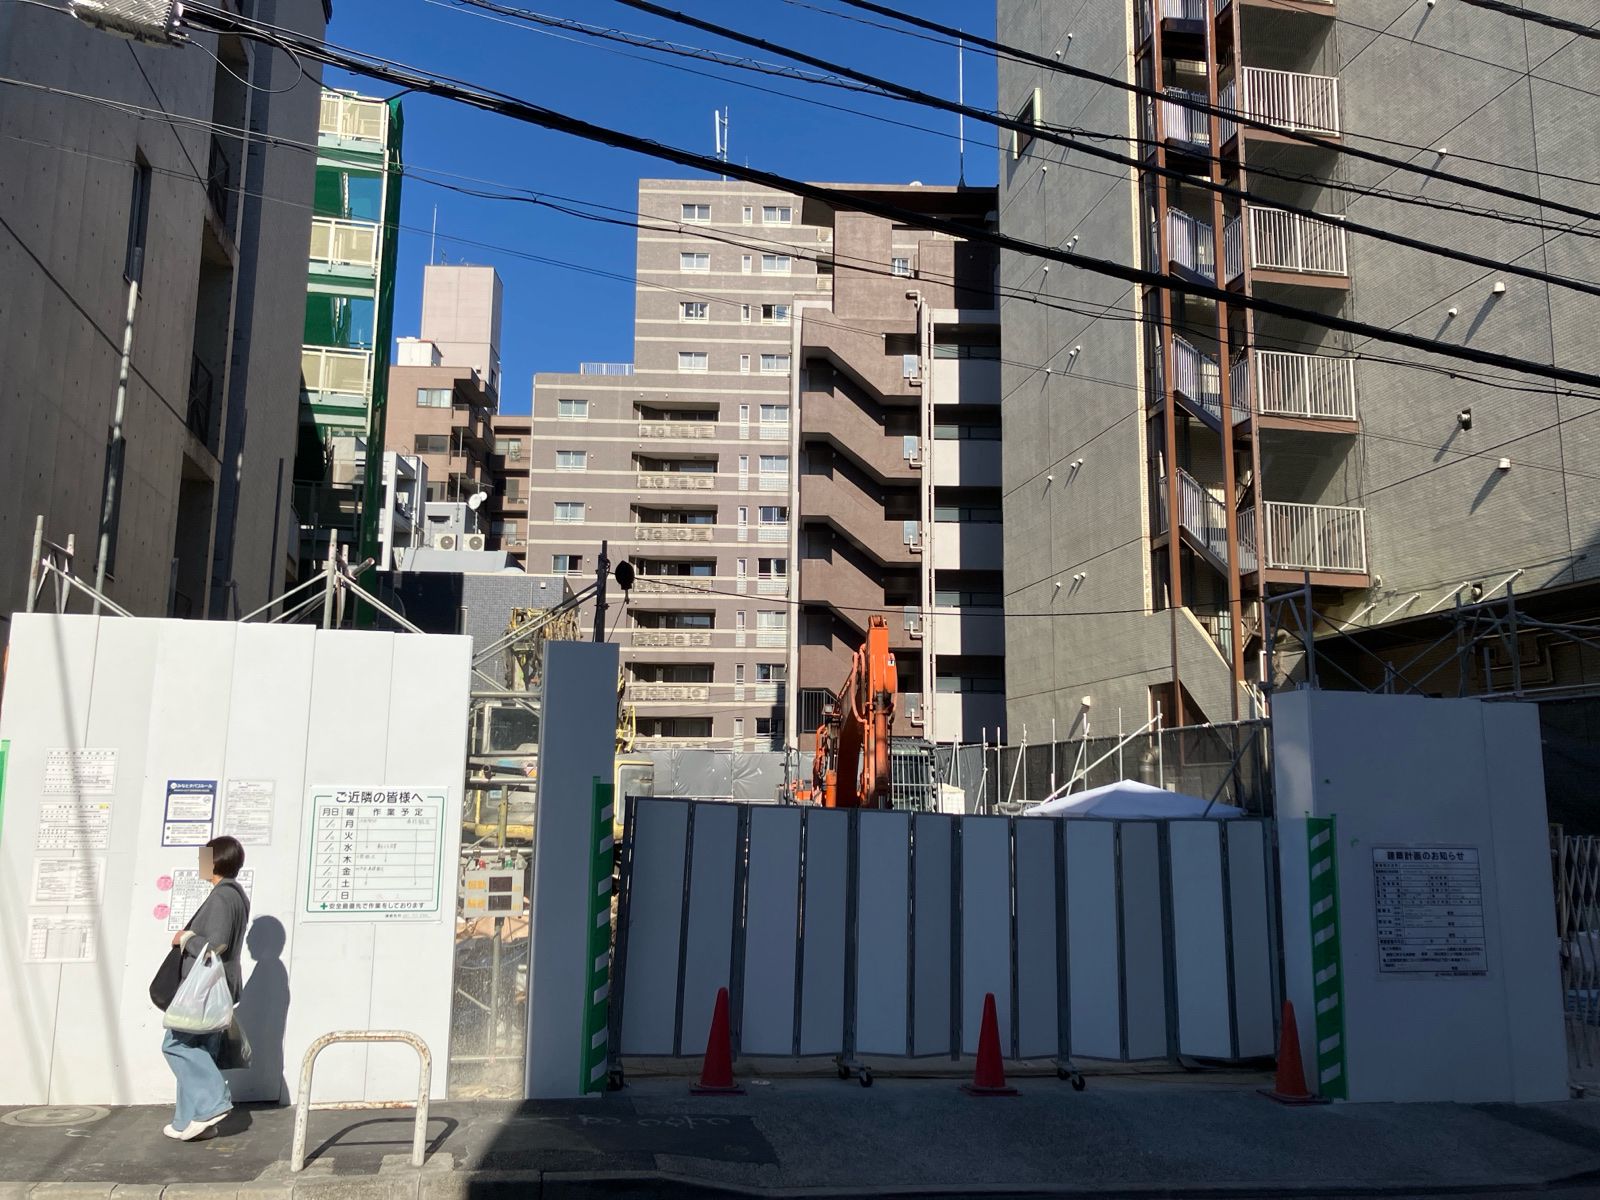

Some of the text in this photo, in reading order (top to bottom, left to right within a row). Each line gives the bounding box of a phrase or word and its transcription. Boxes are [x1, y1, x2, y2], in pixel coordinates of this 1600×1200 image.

[335, 791, 424, 804] ご近隣の皆様へ
[322, 808, 339, 816] 月日
[373, 808, 424, 817] 作業予定
[345, 820, 354, 828] 月
[344, 832, 353, 840] 火
[343, 843, 353, 852] 水
[343, 855, 352, 864] 木
[1387, 851, 1464, 861] 建築計画のお知らせ
[342, 867, 351, 876] 金
[341, 880, 350, 888] 土
[341, 892, 349, 900] 日
[329, 902, 425, 910] 安全最優先で作業をしております
